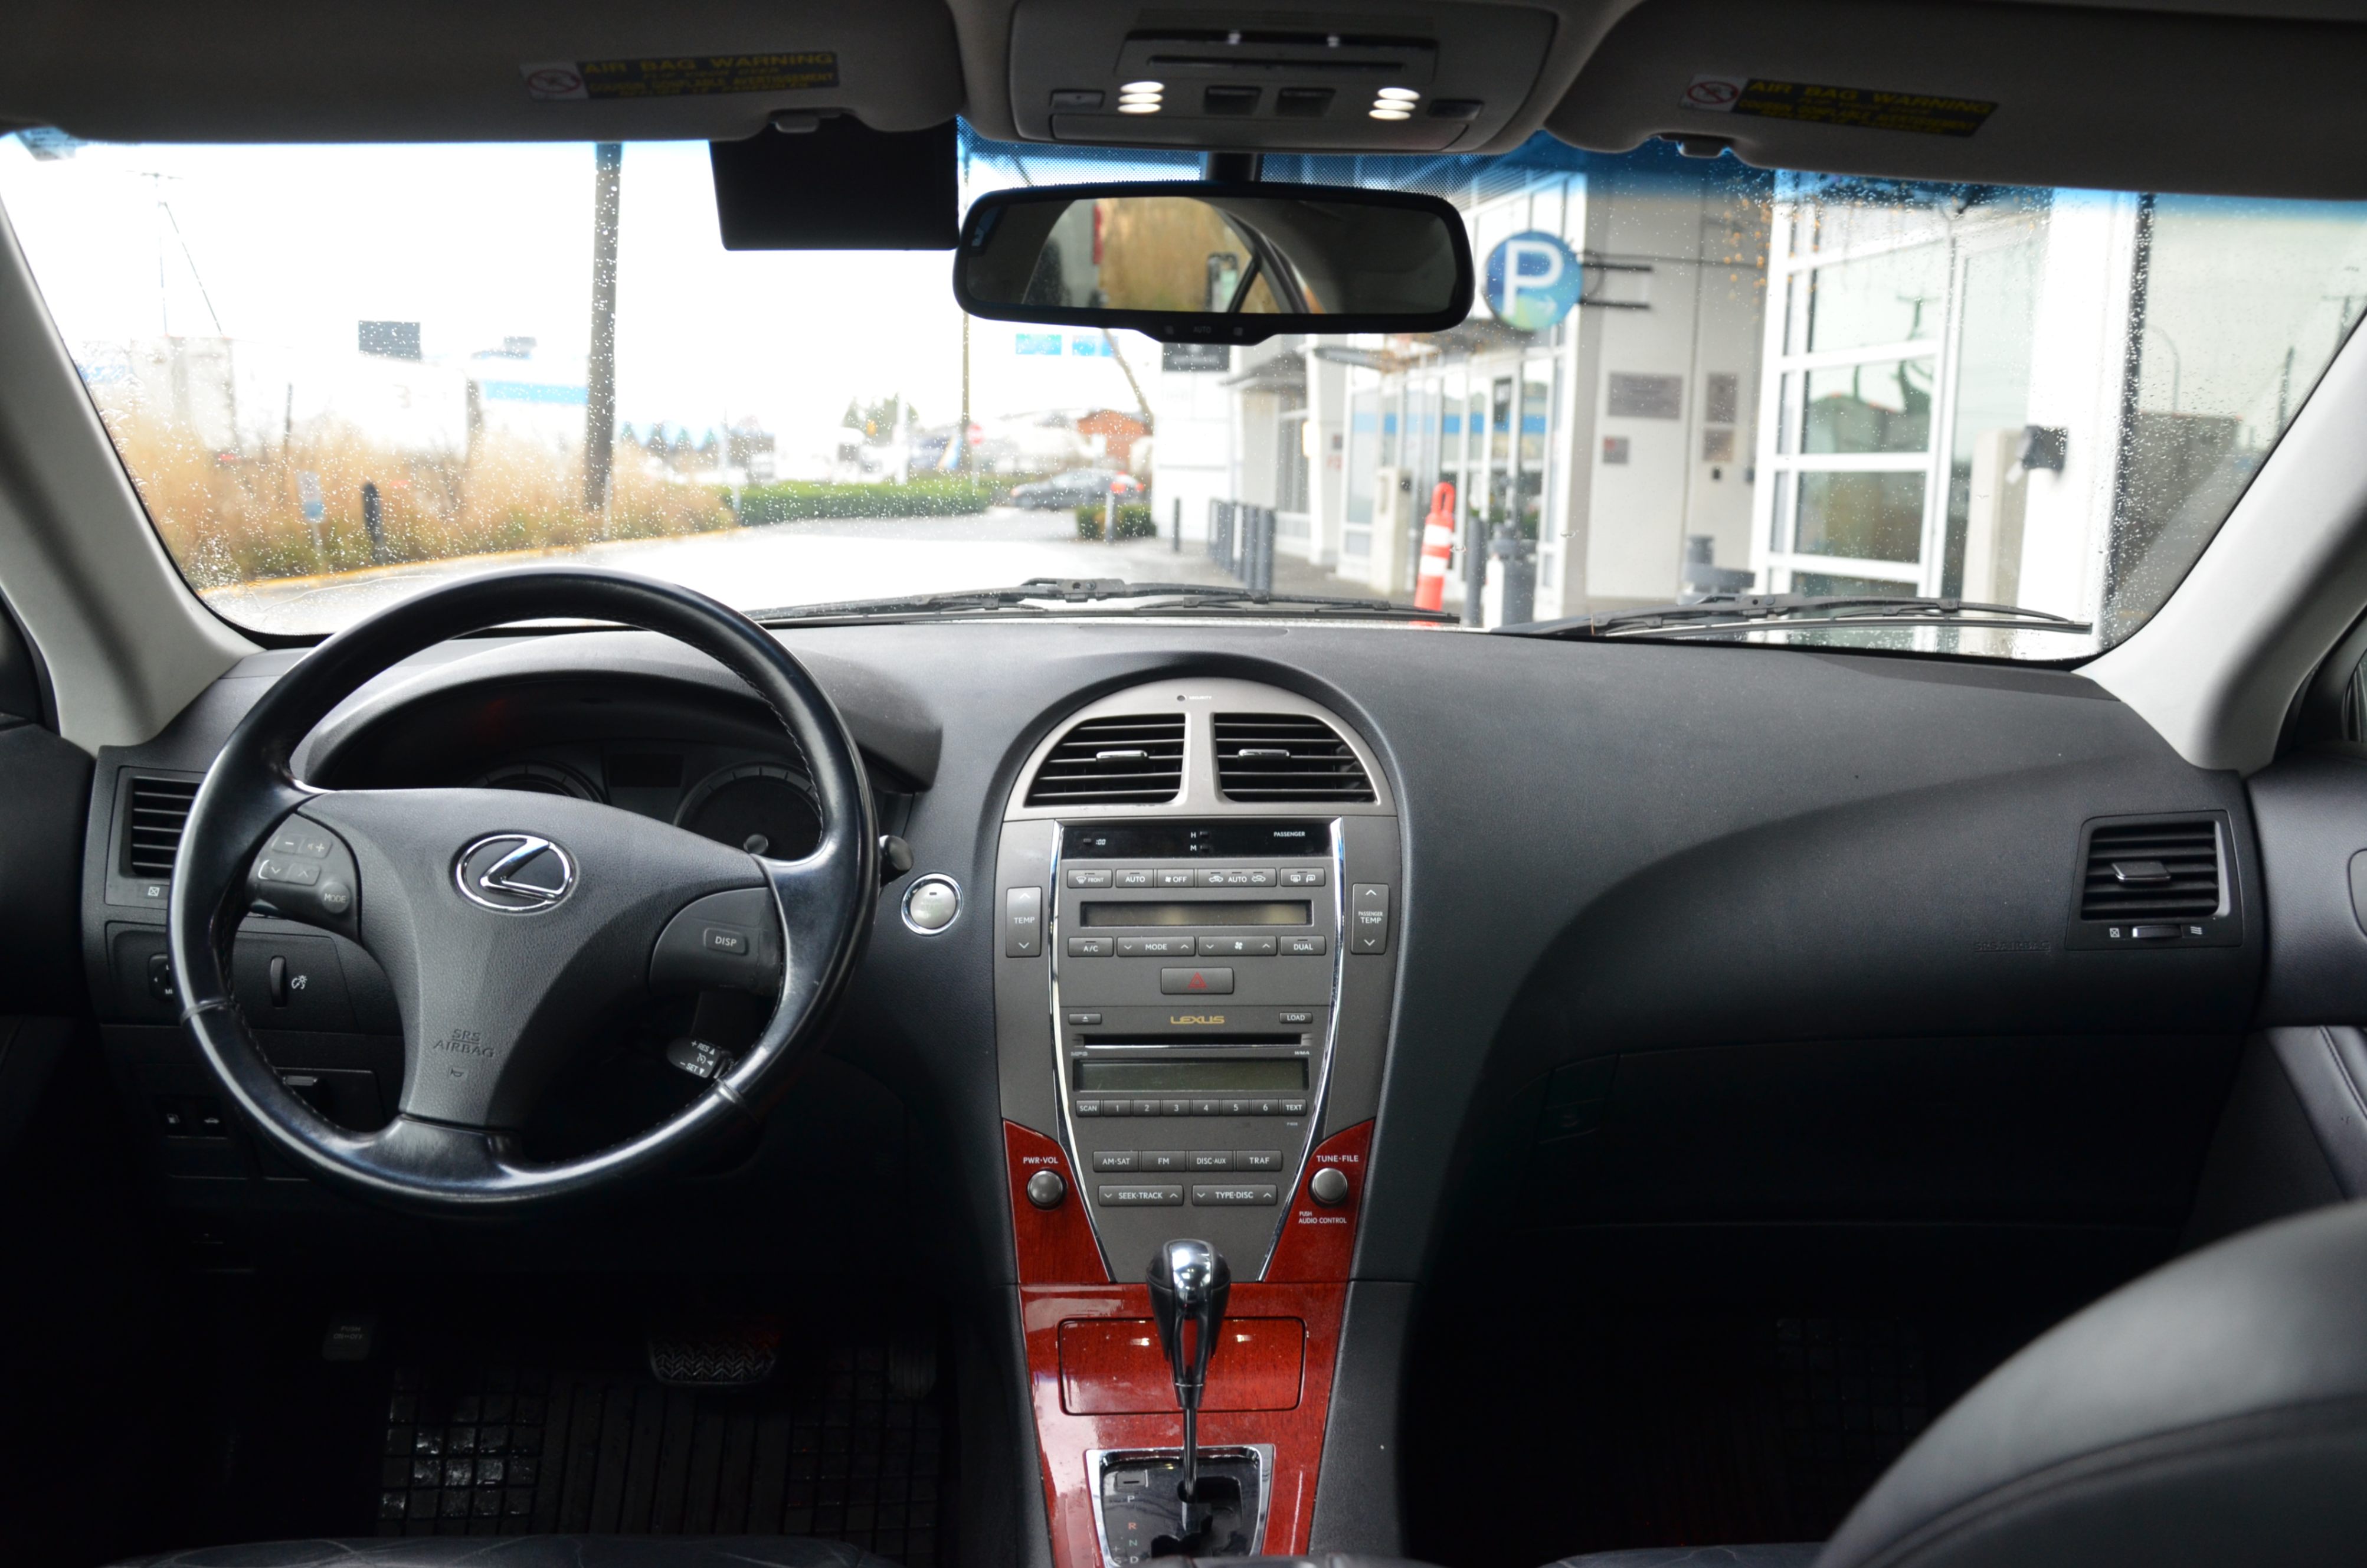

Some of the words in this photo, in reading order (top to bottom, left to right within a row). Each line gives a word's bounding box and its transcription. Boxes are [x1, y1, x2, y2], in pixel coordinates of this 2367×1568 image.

[585, 61, 627, 74] AIR
[640, 58, 696, 73] BAG
[708, 53, 833, 68] WARNING
[1747, 81, 1793, 94] AIR
[1804, 84, 1859, 100] BAG
[1873, 92, 1991, 114] WARNING
[1502, 239, 1563, 317] P
[1193, 325, 1212, 334] AUTO
[323, 892, 346, 904] MODE
[715, 935, 738, 947] DISP
[1170, 1015, 1225, 1024] LEXUS
[451, 1028, 482, 1042] SRS
[433, 1039, 495, 1058] AIRBAG
[696, 1042, 711, 1053] RES
[686, 1062, 699, 1073] SET
[1157, 1157, 1170, 1166] FM
[1127, 1495, 1135, 1503] P
[1128, 1521, 1137, 1530] R
[1128, 1538, 1138, 1547] N
[1130, 1556, 1139, 1564] D
